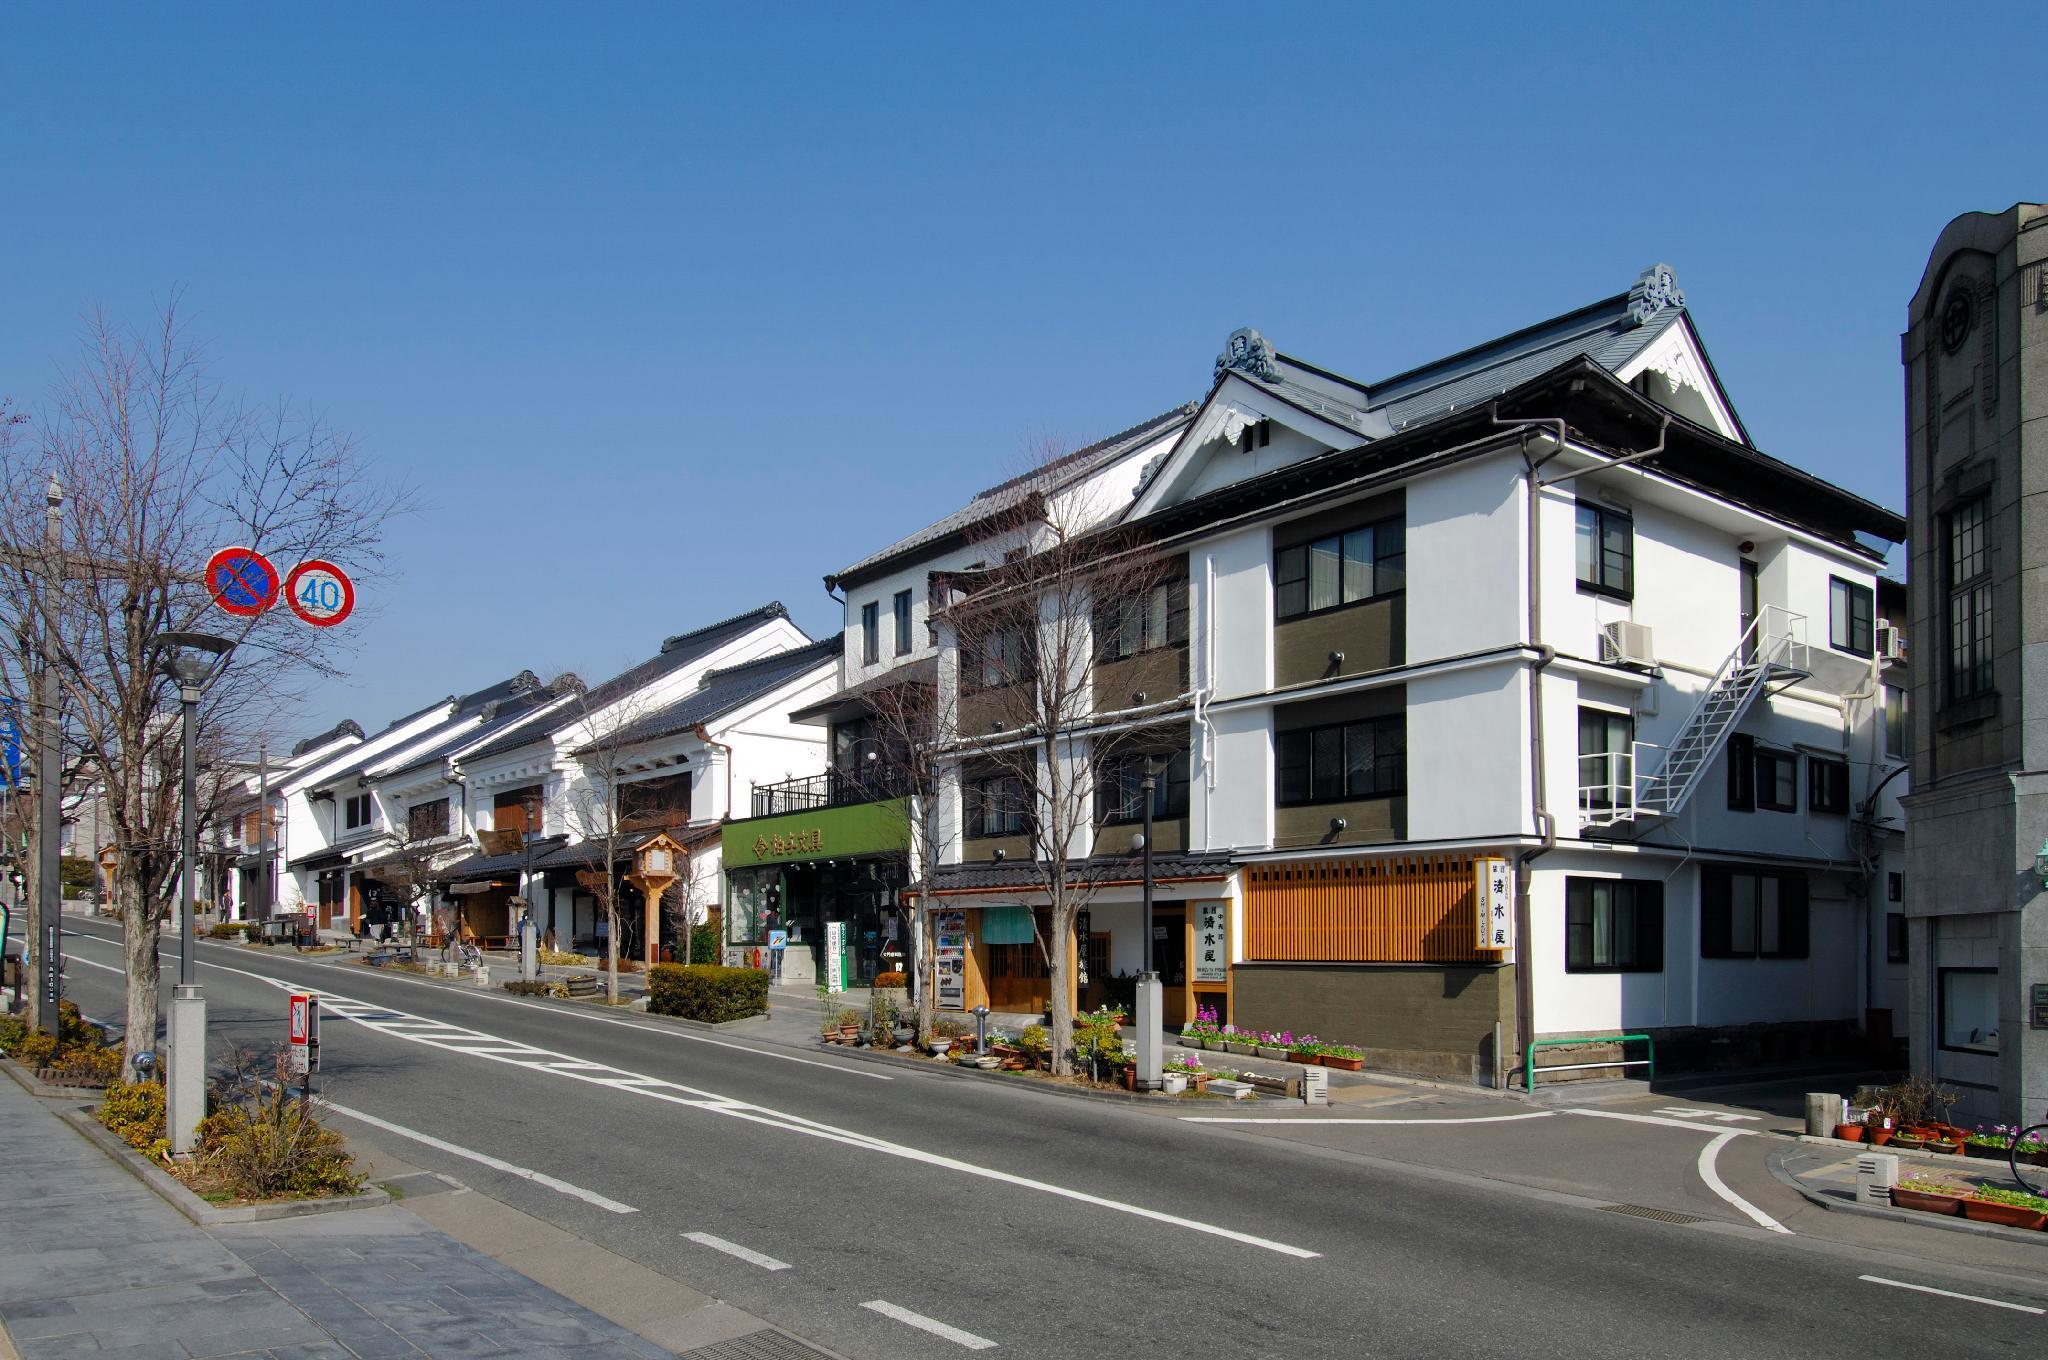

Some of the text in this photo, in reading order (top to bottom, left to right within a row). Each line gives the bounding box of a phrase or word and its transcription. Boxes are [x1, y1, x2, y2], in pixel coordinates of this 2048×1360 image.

[301, 578, 339, 610] 40
[1493, 878, 1506, 945] 清水屋
[1204, 915, 1216, 962] 清水屋
